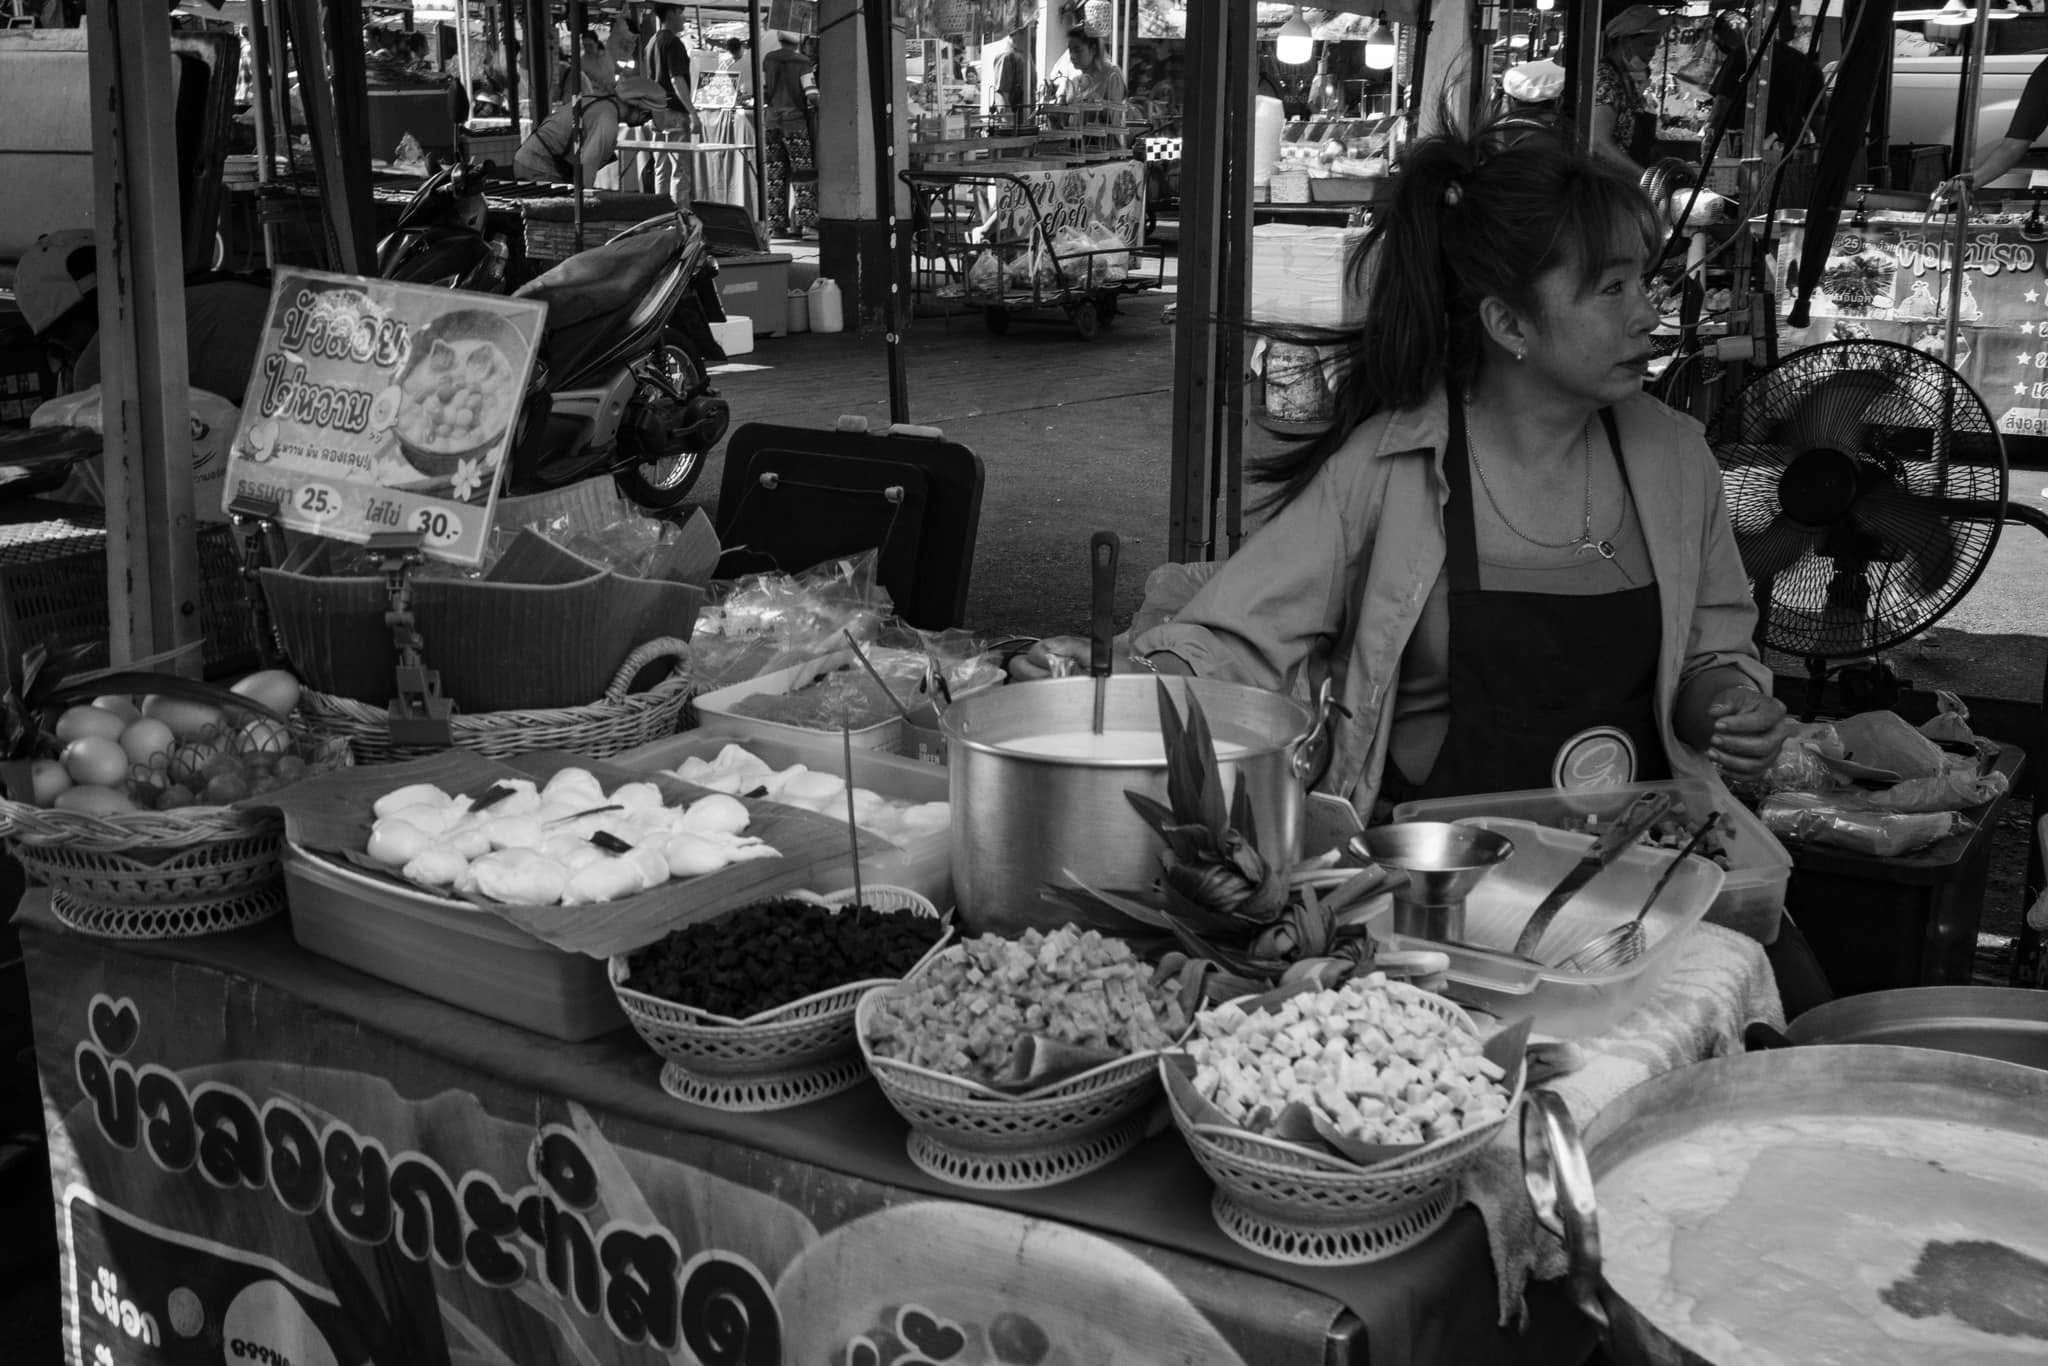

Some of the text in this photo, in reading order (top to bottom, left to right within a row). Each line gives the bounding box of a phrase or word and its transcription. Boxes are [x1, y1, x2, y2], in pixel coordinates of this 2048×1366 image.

[1843, 238, 1858, 249] 25
[279, 289, 412, 368] บัวลอย
[260, 353, 373, 434] ไข่หวาน
[237, 479, 293, 505] ธรรมดา
[301, 487, 337, 515] 25.-
[365, 497, 402, 527] ใส่ไข่
[416, 509, 459, 540] 30.-
[75, 991, 783, 1366] บัวลอยกะทิสด
